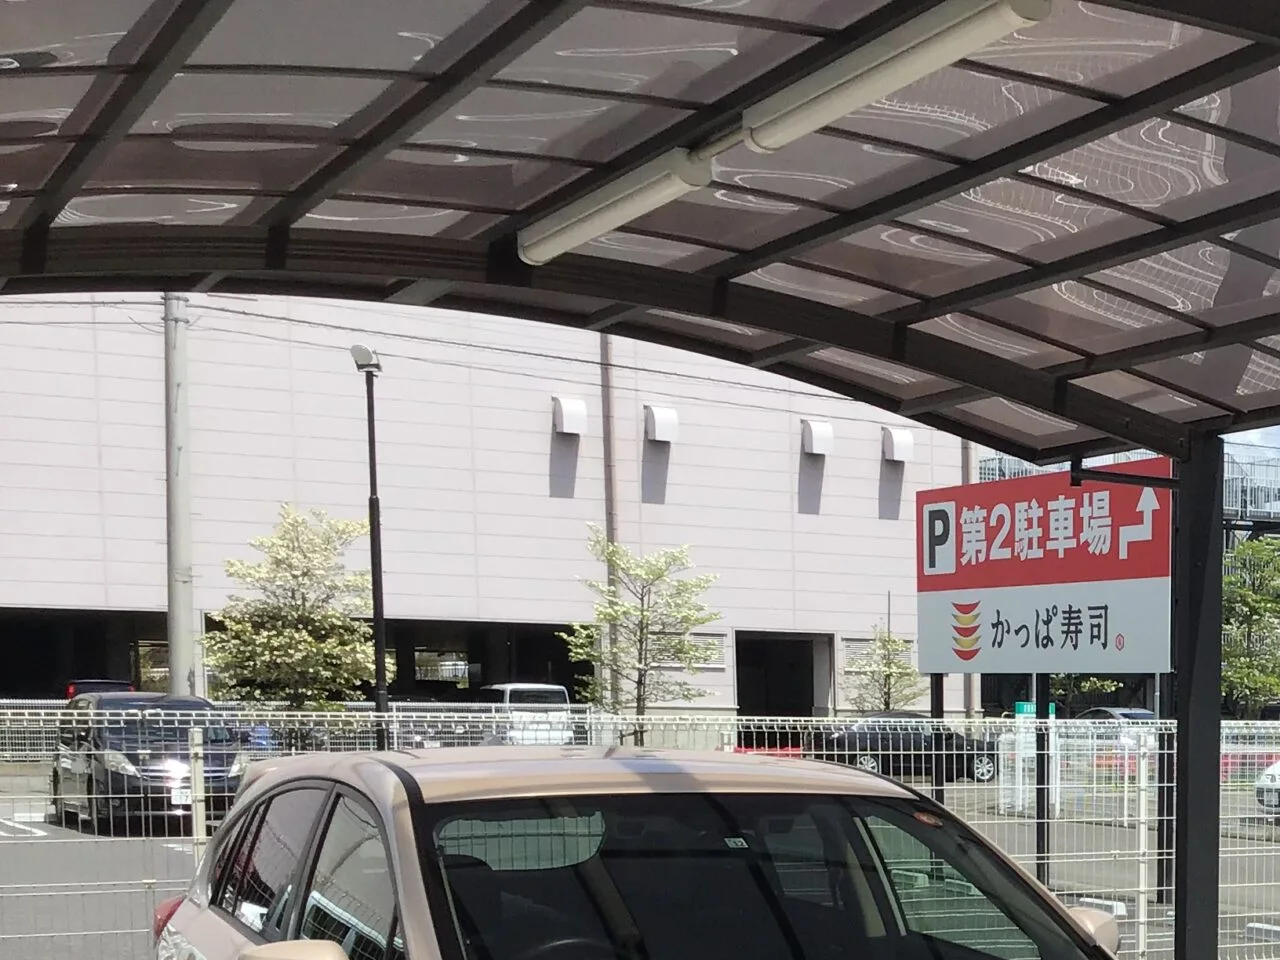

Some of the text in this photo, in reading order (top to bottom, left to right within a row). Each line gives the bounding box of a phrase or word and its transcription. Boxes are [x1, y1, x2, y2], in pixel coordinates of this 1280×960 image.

[928, 490, 1112, 568] P 第2駐車場
[991, 604, 1109, 651] かっぱ寿司
